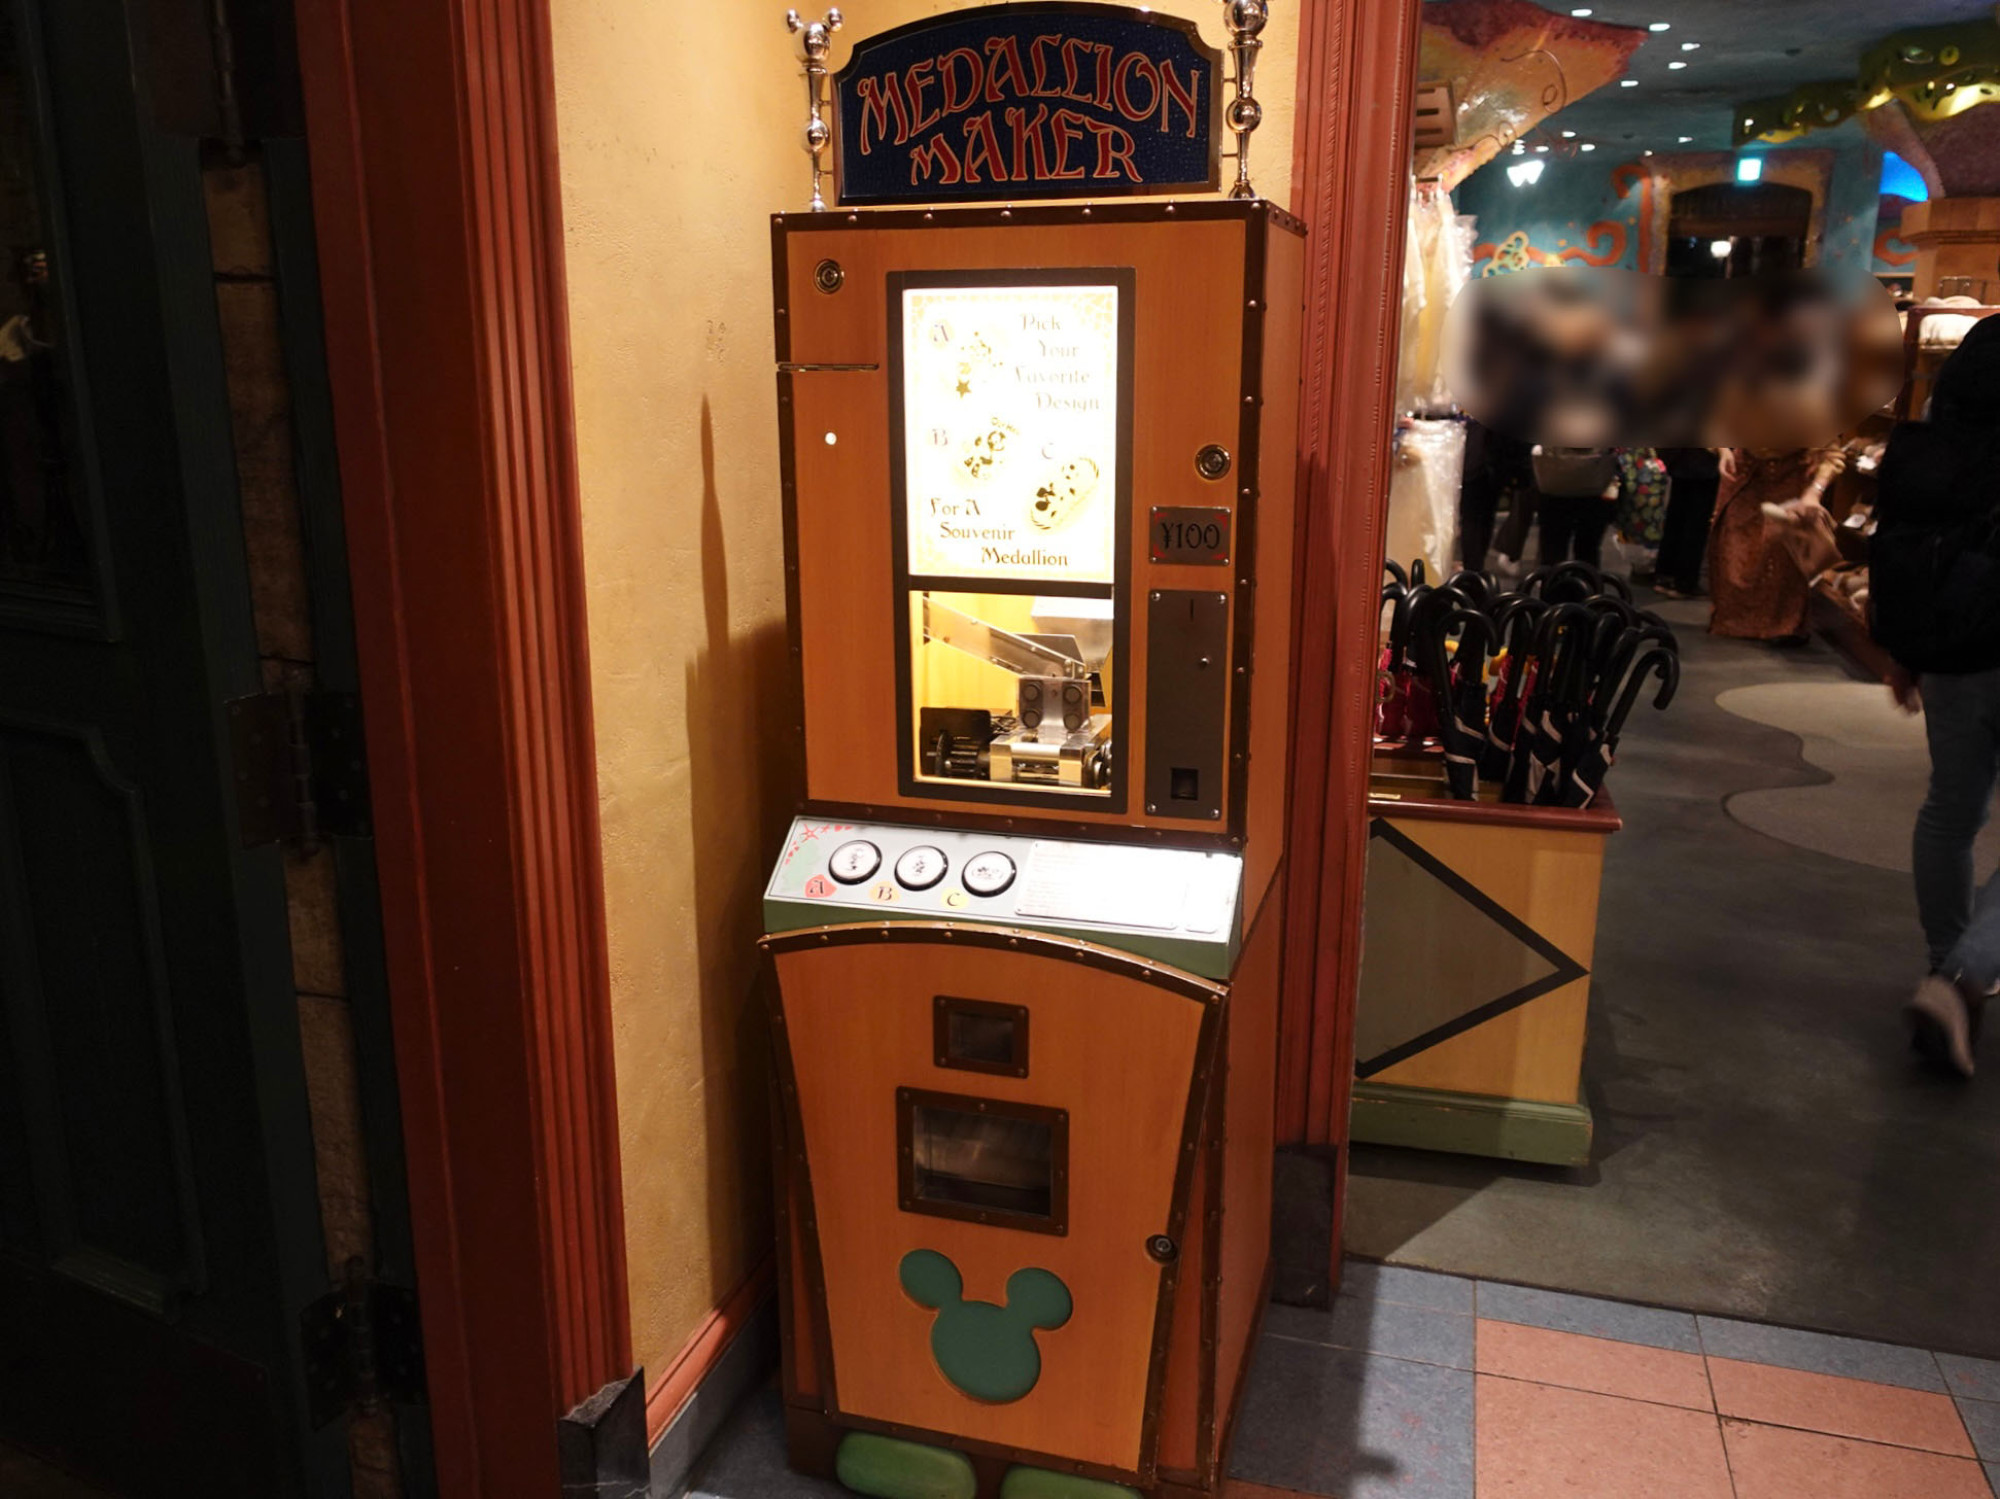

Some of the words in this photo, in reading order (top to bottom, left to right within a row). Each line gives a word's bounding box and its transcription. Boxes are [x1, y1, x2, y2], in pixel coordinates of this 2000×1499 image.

[857, 33, 1200, 155] MEDALLION
[910, 103, 1143, 186] MAKER
[1021, 314, 1062, 331] Pick
[1038, 340, 1080, 358] Your
[1015, 365, 1091, 383] Favorite
[1036, 392, 1100, 411] Design
[930, 497, 960, 516] For
[965, 498, 981, 516] A
[940, 521, 1015, 541] Souvenir
[981, 547, 1068, 567] Medallion
[877, 886, 893, 901] B
